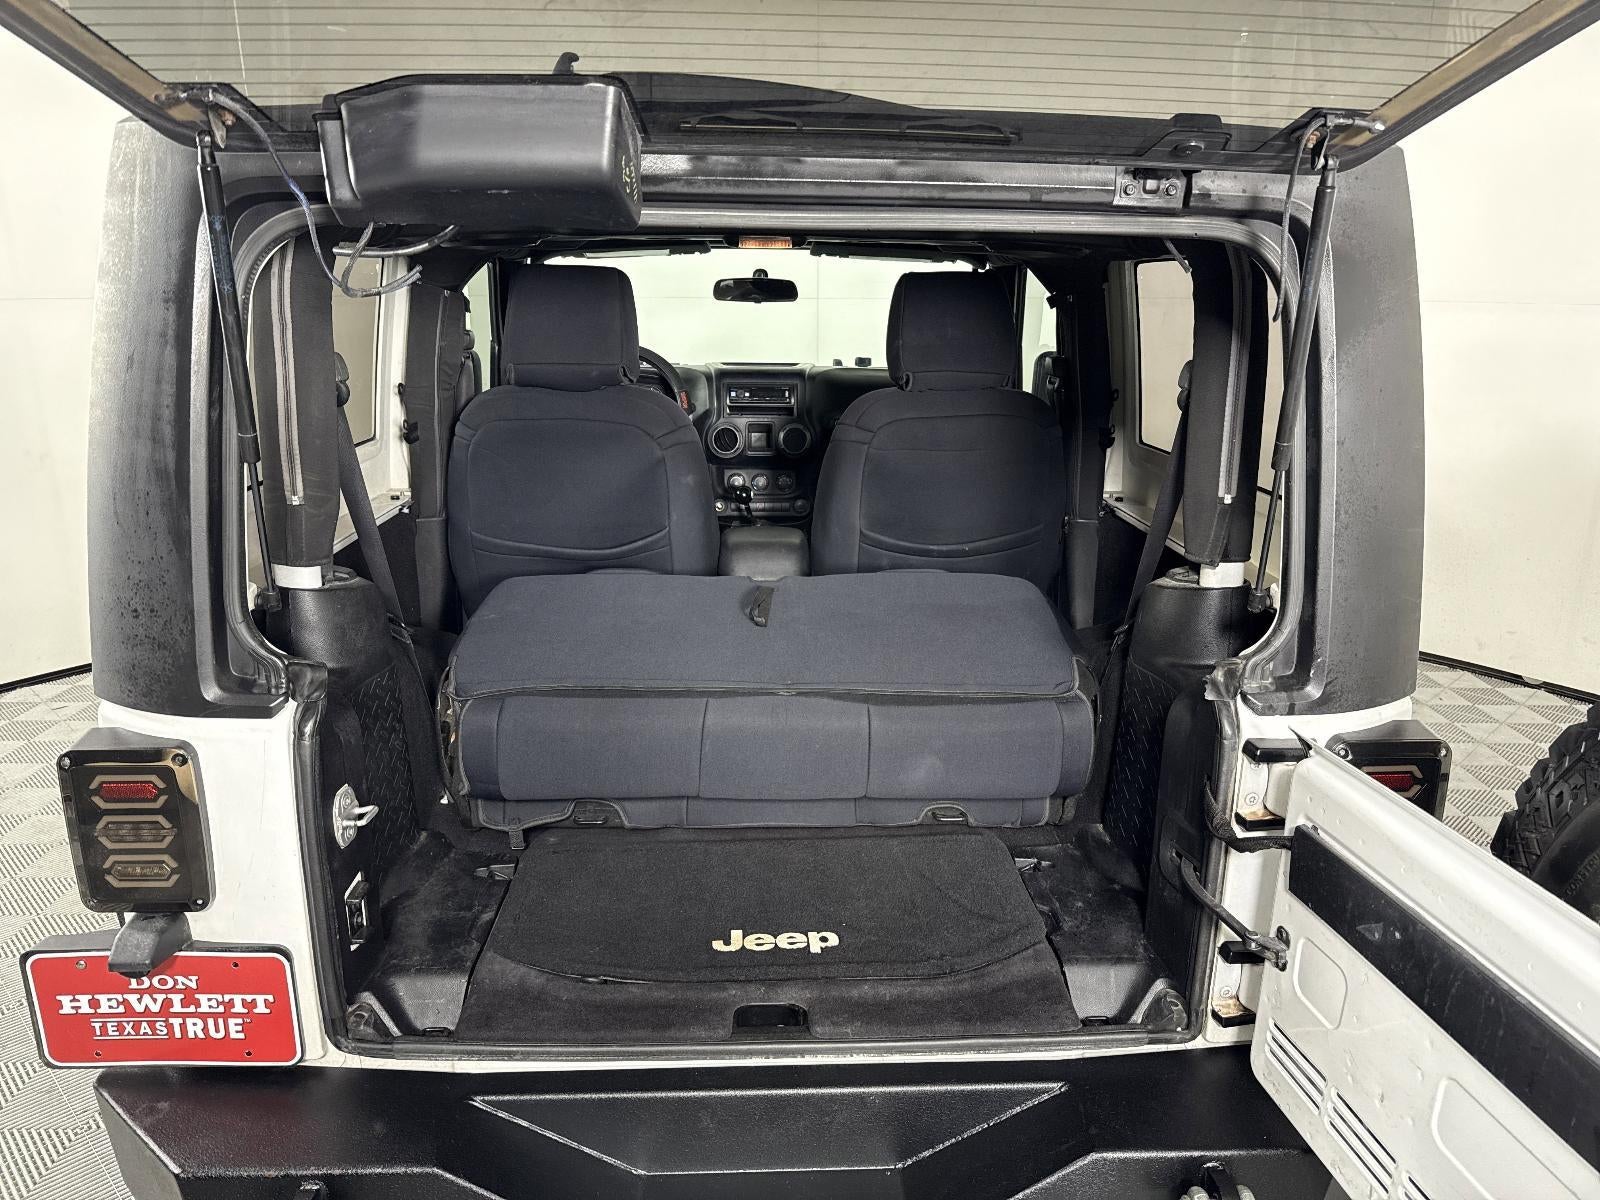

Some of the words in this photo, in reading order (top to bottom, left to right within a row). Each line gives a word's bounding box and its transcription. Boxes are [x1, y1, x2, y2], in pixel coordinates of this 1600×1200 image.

[711, 929, 840, 954] Jeep
[128, 974, 199, 990] DON
[56, 993, 275, 1015] HEWLETT
